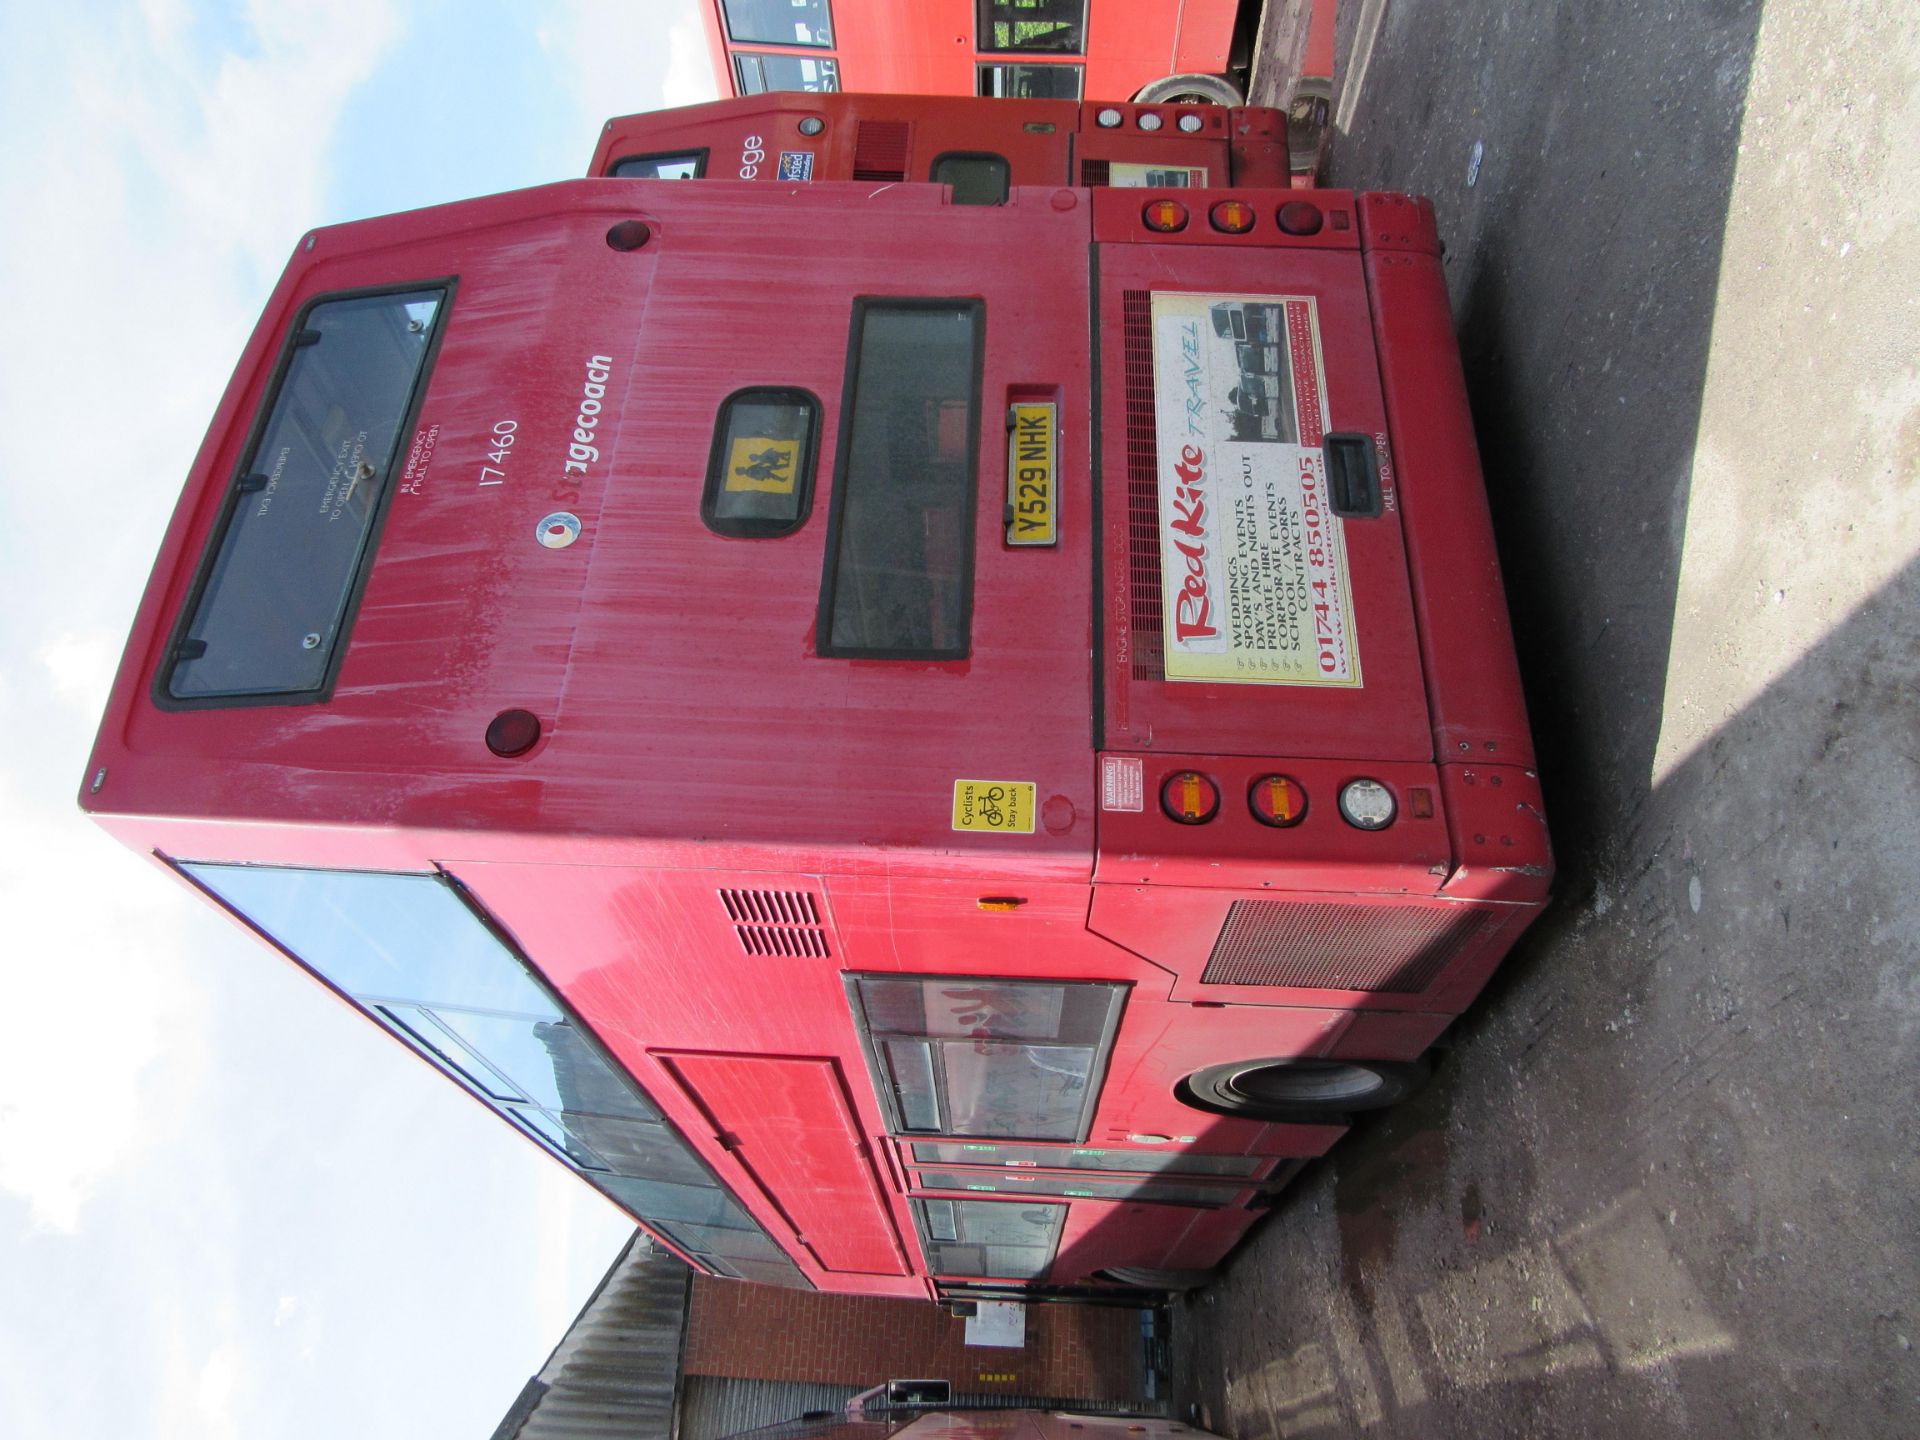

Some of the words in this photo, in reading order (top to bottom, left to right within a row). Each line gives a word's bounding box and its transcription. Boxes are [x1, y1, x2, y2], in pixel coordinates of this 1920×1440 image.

[739, 135, 765, 181] ege
[1287, 301, 1298, 346] SEATER
[1294, 303, 1304, 329] HIRE
[1297, 333, 1308, 374] COACH
[1303, 312, 1317, 382] OCCASIONS
[1181, 321, 1203, 436] TRAVEL
[1310, 384, 1319, 406] ALL
[1301, 377, 1316, 446] EXECUTIVE
[1312, 408, 1322, 435] FOR
[404, 430, 427, 479] EMERGENCY
[419, 450, 432, 464] TO
[424, 424, 440, 449] OPEN
[478, 420, 518, 487] 17460
[1019, 416, 1047, 461] NHK
[319, 461, 344, 513] EMERGENCY
[337, 440, 351, 459] EXIT
[335, 482, 351, 507] OPEN
[399, 483, 411, 494] IN
[412, 465, 428, 487] PULL
[1170, 444, 1205, 537] Kite
[1242, 454, 1253, 488] OUT
[329, 509, 342, 522] TO
[1018, 467, 1047, 532] Y529
[1245, 494, 1258, 552] NIGHTS
[1265, 482, 1279, 540] EVENTS
[1298, 456, 1325, 567] 850505
[1383, 487, 1395, 512] PULL
[1235, 499, 1248, 558] EVENTS
[1278, 497, 1291, 556] WORKS
[1250, 558, 1261, 595] AND
[1260, 542, 1271, 578] HIRE
[1290, 510, 1308, 612] CONTRACTS
[1317, 452, 1347, 674] www.redkitetravel.co.uk
[1173, 539, 1217, 642] Red
[1228, 556, 1243, 649] WEDDINGS
[1240, 564, 1255, 649] SPORTING
[1272, 546, 1289, 651] CORPORATE
[1253, 602, 1266, 650] DAY'S
[1263, 584, 1278, 650] PRIVATE
[1285, 579, 1301, 651] SCHOOL
[1311, 579, 1337, 673] 01744
[1116, 625, 1128, 663] ENGINE
[961, 785, 974, 826] Cyclists
[1007, 809, 1017, 828] Stay
[1008, 787, 1017, 807] back
